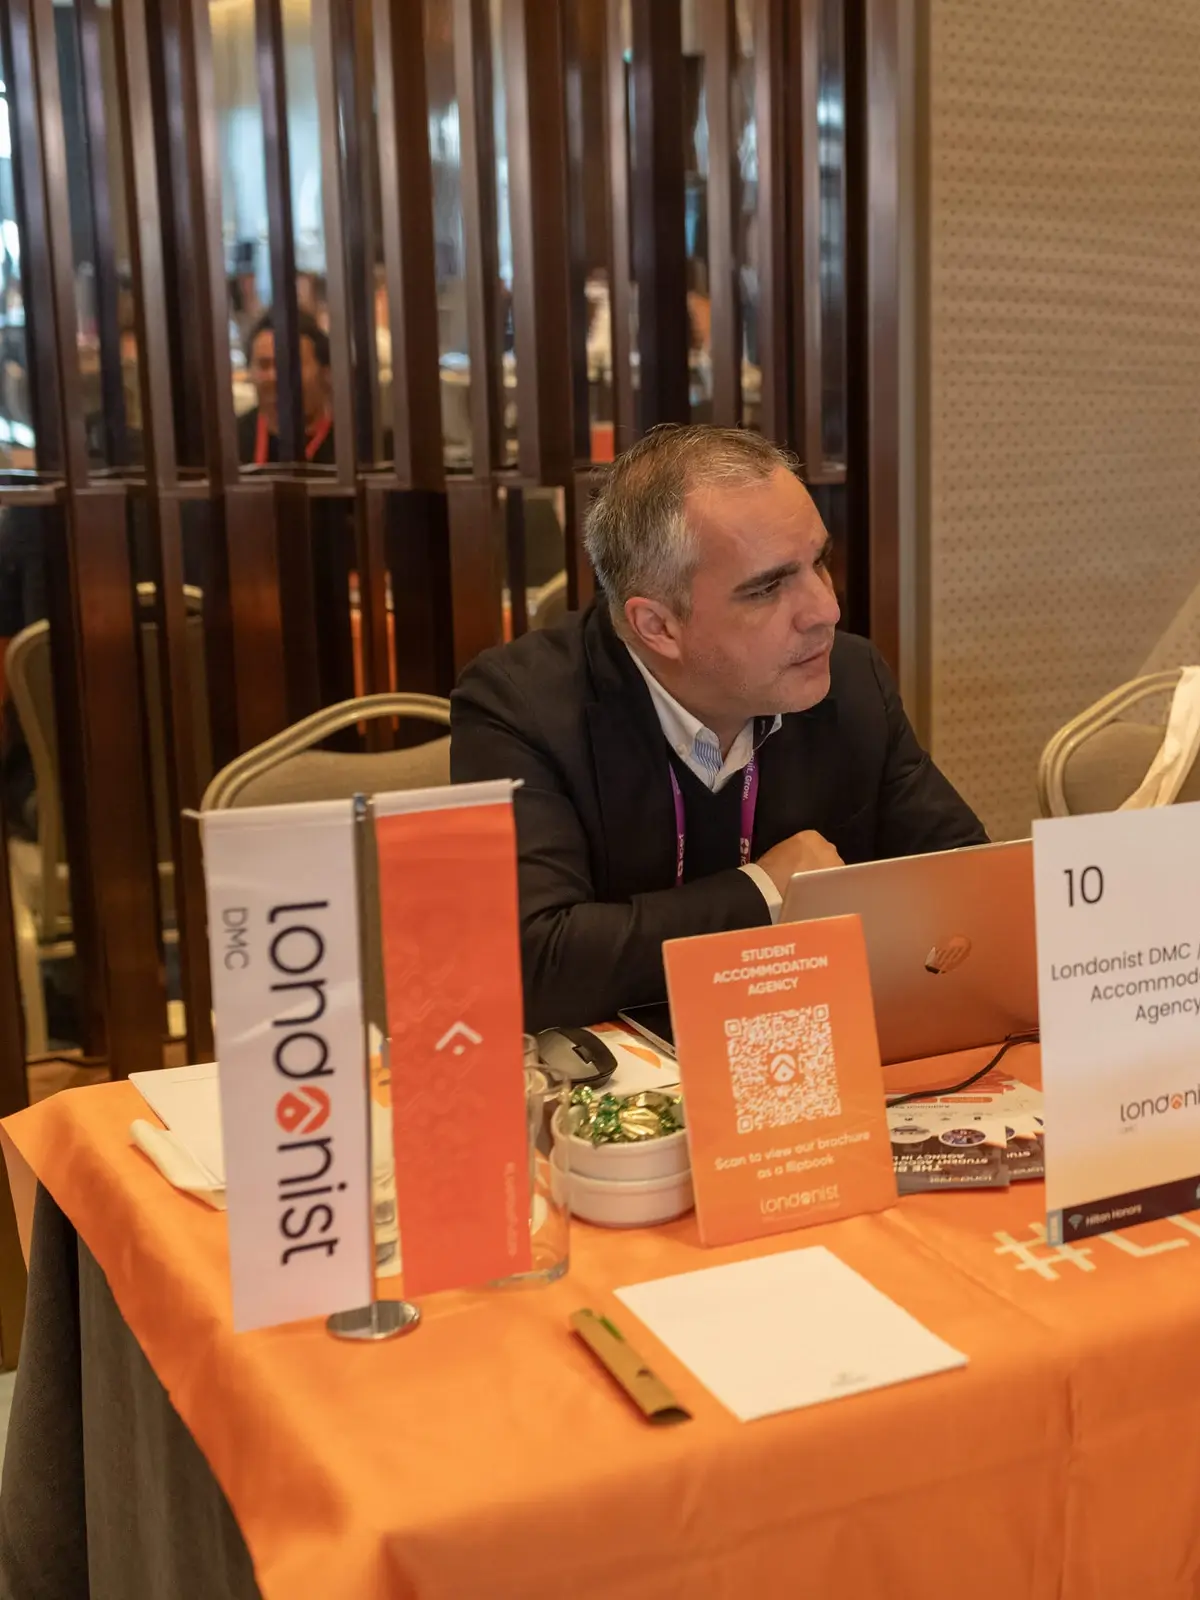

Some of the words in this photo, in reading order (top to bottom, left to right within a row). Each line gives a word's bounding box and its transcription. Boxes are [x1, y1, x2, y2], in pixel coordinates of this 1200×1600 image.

[1063, 864, 1104, 908] 10
[221, 906, 250, 971] DMC
[740, 942, 796, 963] STUDENT
[712, 955, 829, 985] ACCOMMODATION
[1051, 949, 1144, 982] Londonist
[1149, 942, 1193, 969] DMC
[747, 977, 800, 997] AGENCY
[267, 900, 347, 1266] londonist
[714, 1153, 748, 1172] Scan
[748, 1148, 763, 1164] to
[764, 1144, 794, 1162] view
[794, 1141, 817, 1156] our
[817, 1129, 871, 1153] brochure
[757, 1167, 772, 1180] as
[785, 1153, 836, 1176] flipbook
